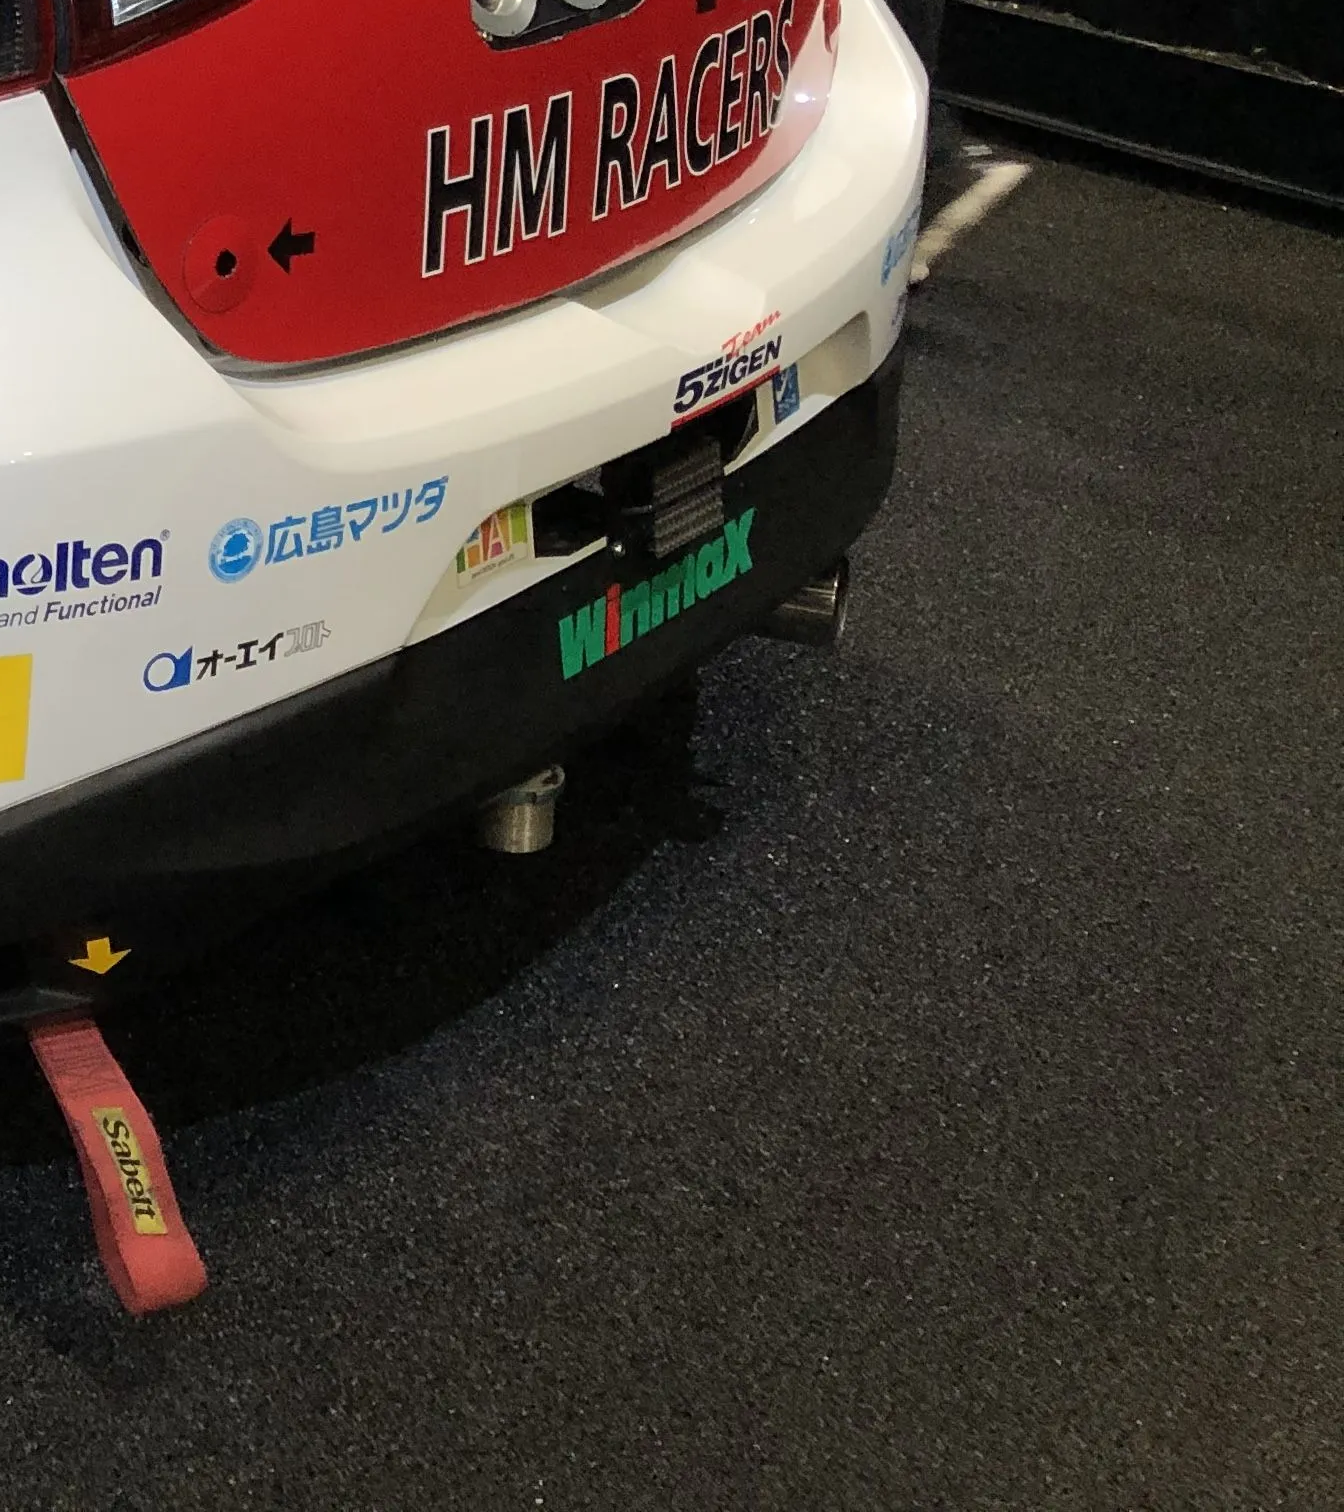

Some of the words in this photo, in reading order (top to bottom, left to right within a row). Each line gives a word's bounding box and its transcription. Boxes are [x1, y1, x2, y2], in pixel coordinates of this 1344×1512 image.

[421, 91, 574, 279] HM
[264, 475, 449, 566] 広島マツダ
[43, 585, 163, 624] Functional
[102, 1113, 157, 1223] Sabelt
